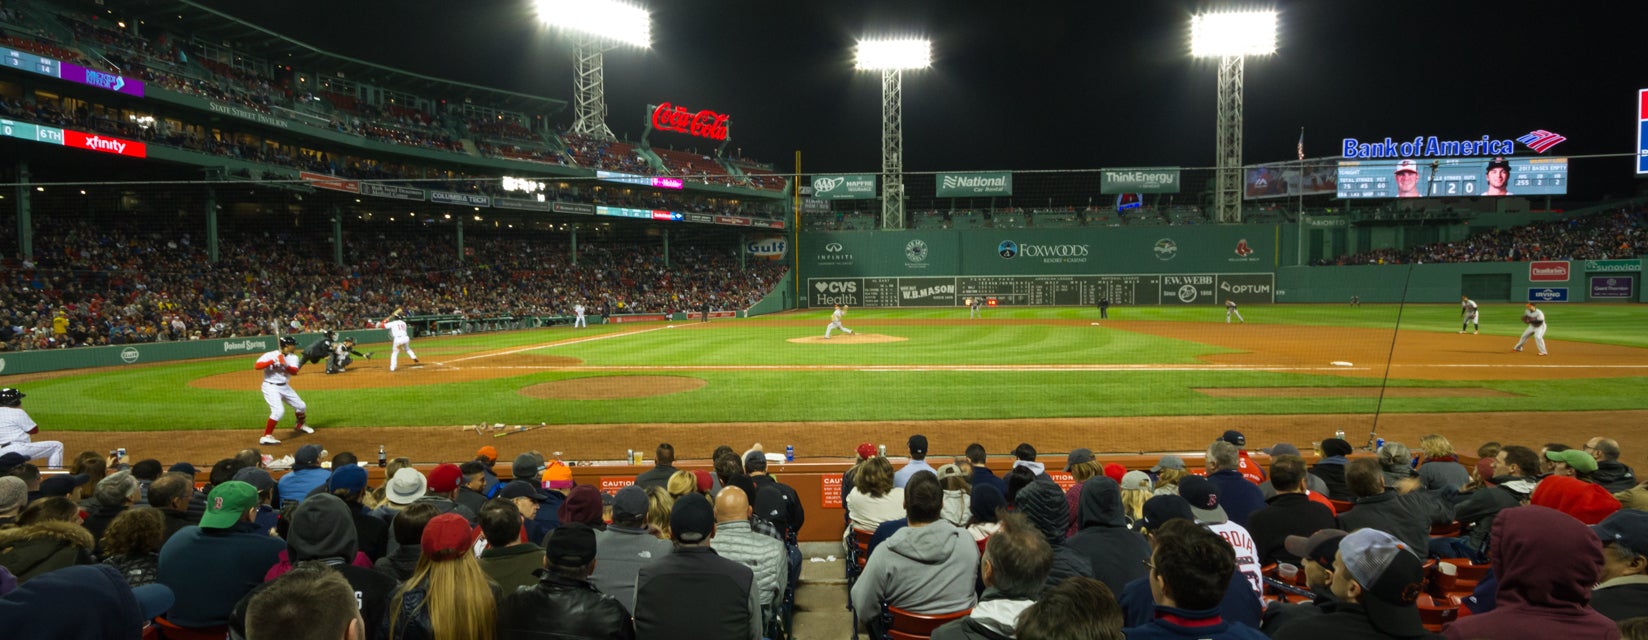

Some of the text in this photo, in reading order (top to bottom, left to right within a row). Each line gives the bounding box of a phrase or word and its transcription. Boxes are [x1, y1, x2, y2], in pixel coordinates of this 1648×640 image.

[41, 65, 51, 73] 14
[4, 126, 12, 135] 0
[85, 135, 126, 154] xfinity
[1342, 135, 1515, 158] Bank of America
[956, 175, 1006, 187] National
[1432, 183, 1437, 194] 1
[1447, 182, 1456, 194] 2
[1465, 182, 1473, 193] 0
[747, 241, 785, 253] Gulf
[1020, 243, 1089, 257] FOXWOODS
[1183, 276, 1213, 285] WEBB
[828, 281, 857, 293] CVS
[1231, 285, 1270, 294] OPTUM
[816, 293, 858, 305] Health
[223, 339, 266, 352] Poland Spring
